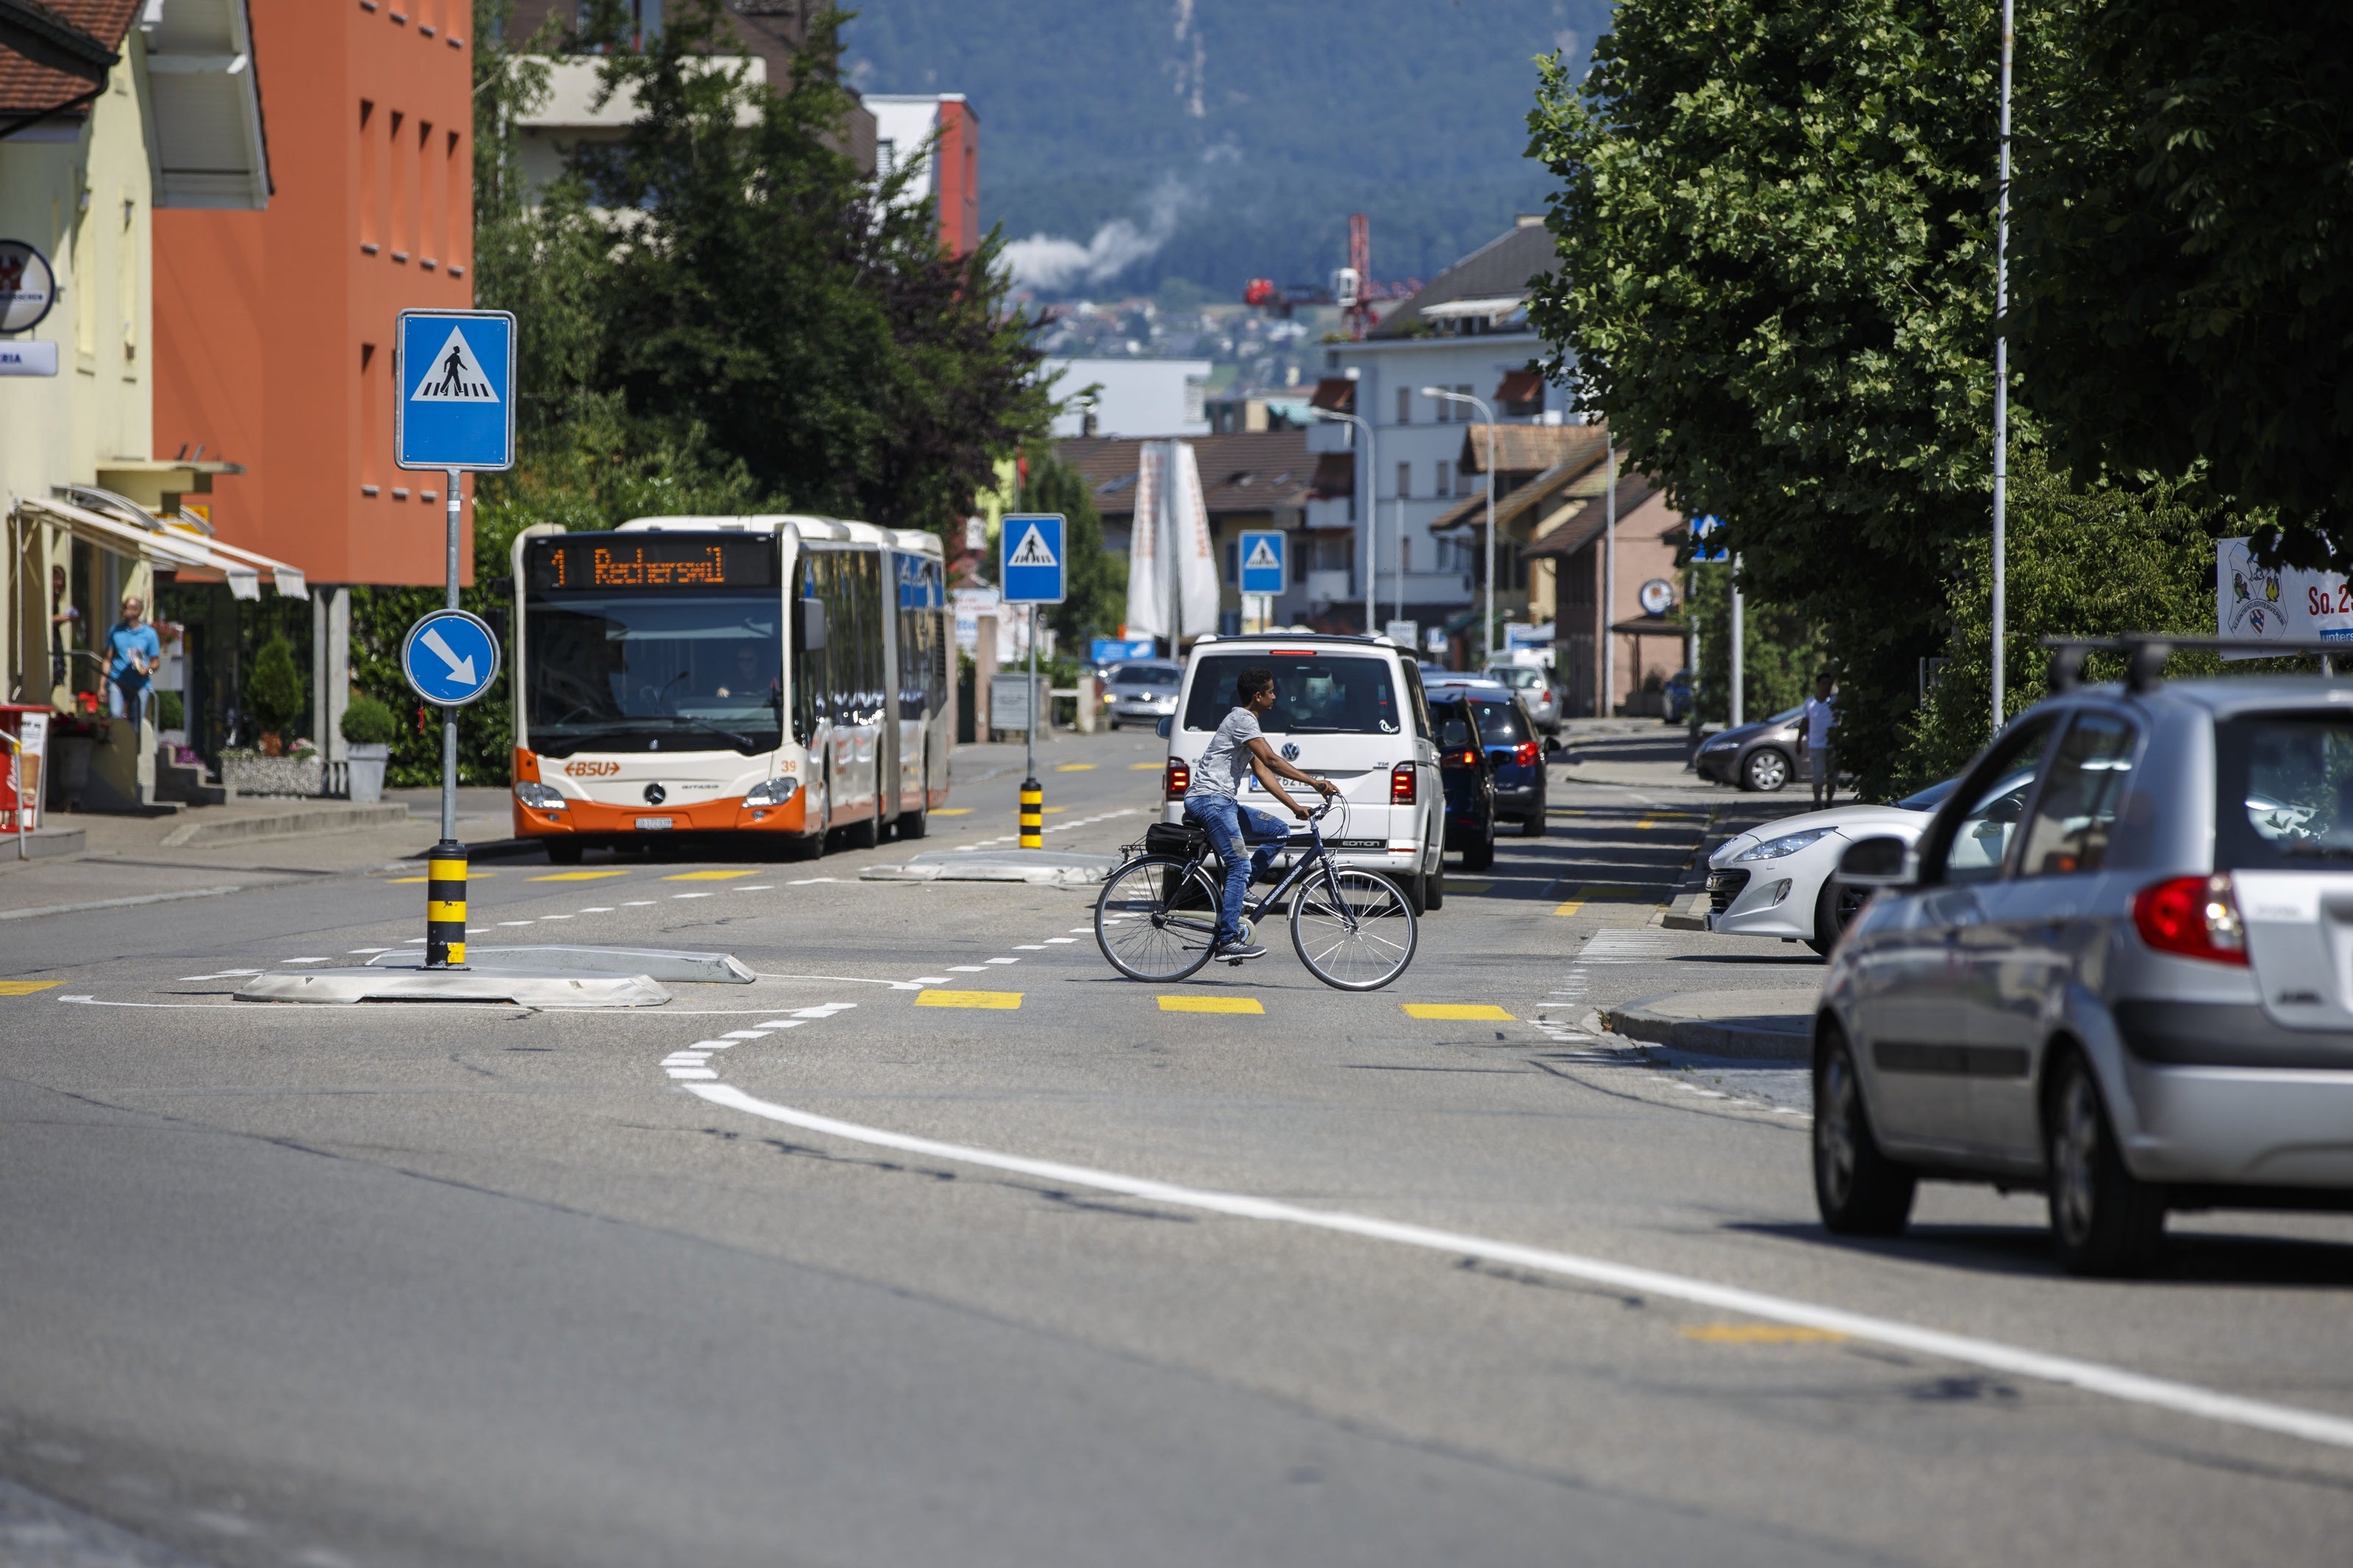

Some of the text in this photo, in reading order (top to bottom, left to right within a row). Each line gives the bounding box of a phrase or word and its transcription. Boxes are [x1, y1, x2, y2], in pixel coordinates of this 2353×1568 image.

[551, 547, 725, 585] 1 Recherswil
[2308, 586, 2335, 616] So.
[575, 762, 610, 776] BSU
[780, 760, 796, 772] 39
